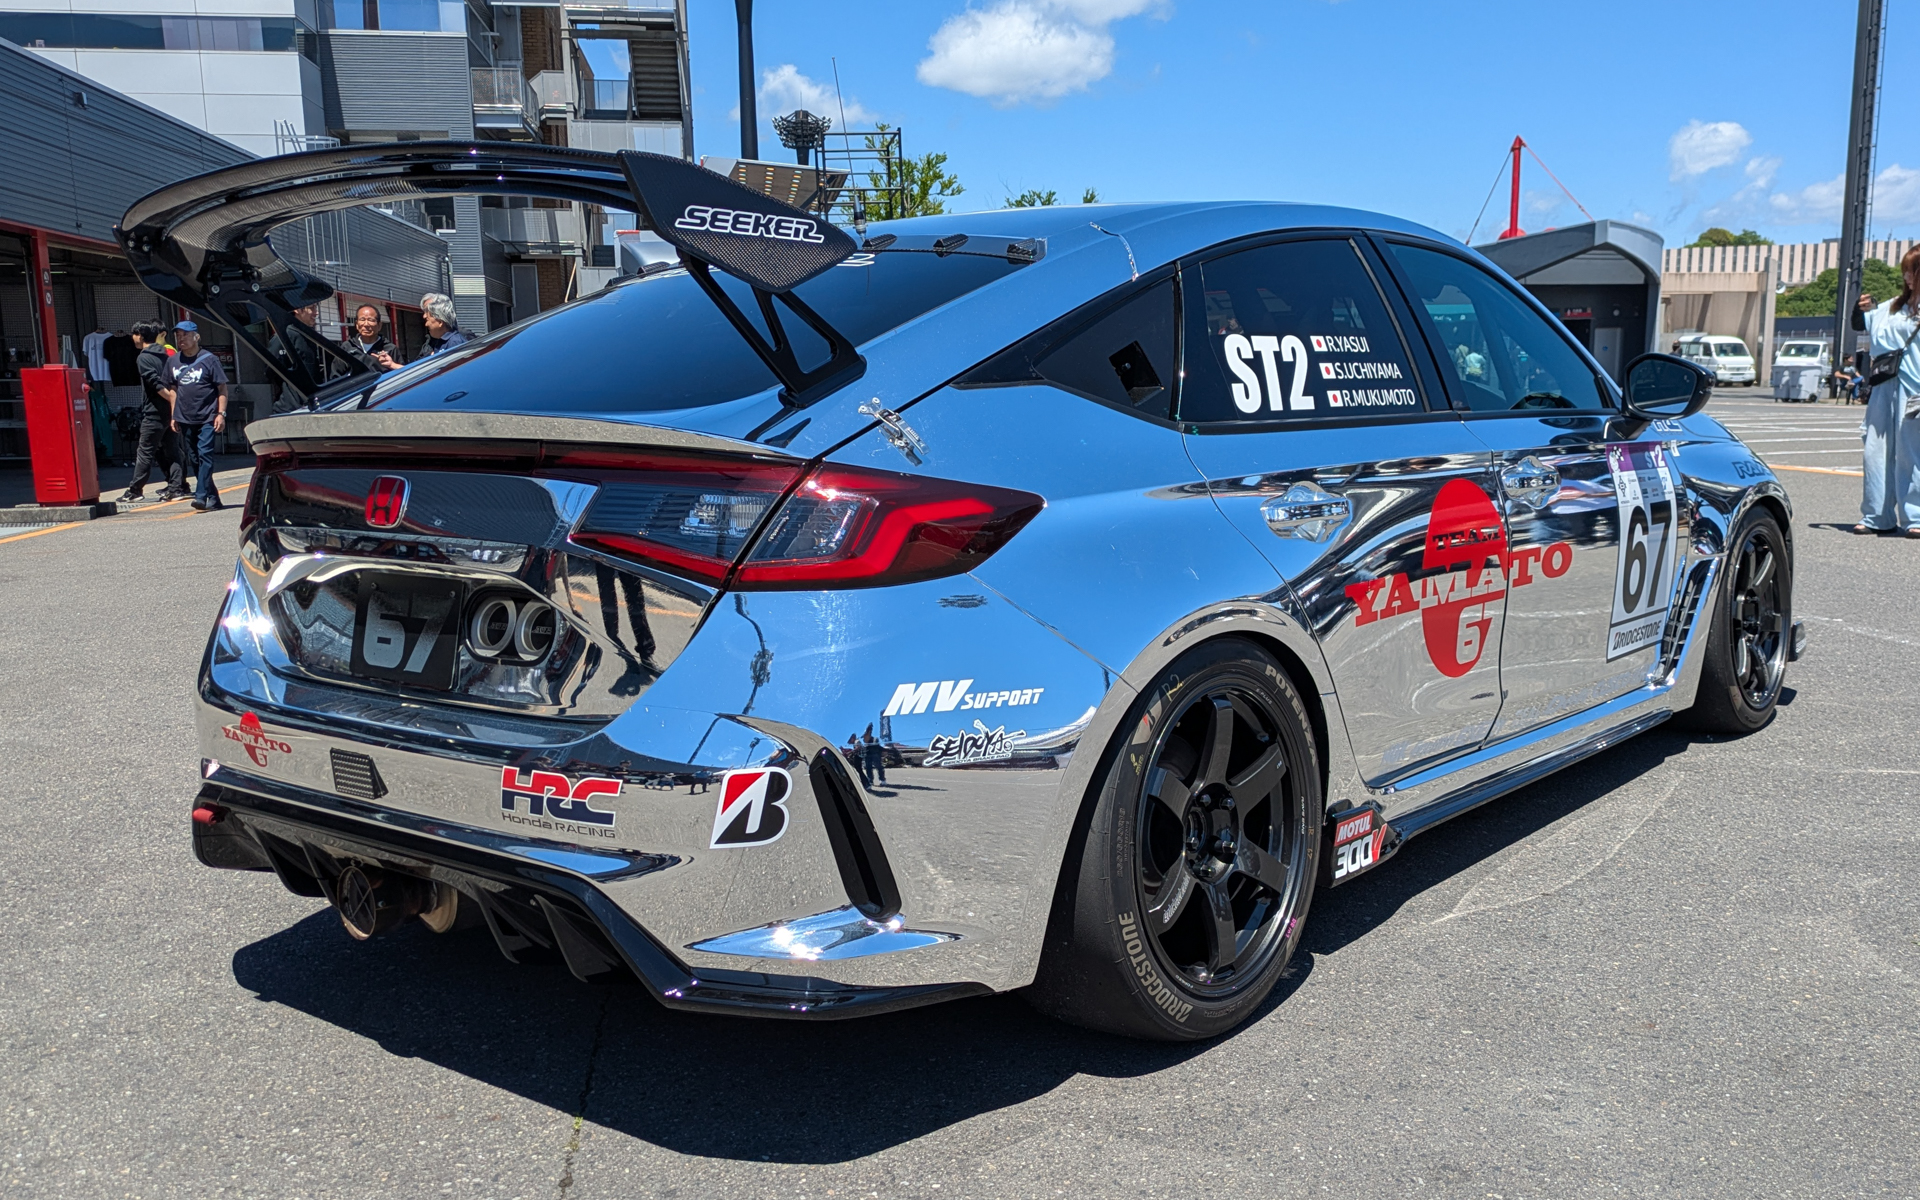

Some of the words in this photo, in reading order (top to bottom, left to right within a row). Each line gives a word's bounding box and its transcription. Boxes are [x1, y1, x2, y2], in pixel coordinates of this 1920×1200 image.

[675, 205, 825, 243] SEEKER
[1327, 335, 1370, 353] R.YASUI
[1224, 334, 1315, 413] ST2
[1334, 362, 1402, 379] S.UCHIYAMA
[1343, 388, 1416, 407] R.MUKUMOTO
[1432, 525, 1501, 551] TEAM
[1622, 500, 1672, 614] 67
[1344, 542, 1573, 627] YAMATO
[363, 590, 454, 674] 67
[1456, 603, 1494, 665] 6
[1612, 620, 1662, 651] BRIDGESTONE
[883, 679, 974, 717] MV
[960, 688, 1044, 710] SUPPORT
[1264, 664, 1317, 768] POTENZA
[221, 726, 292, 754] YAMATO
[501, 765, 623, 827] HRC
[502, 812, 551, 829] Honda
[555, 821, 615, 838] RACING
[1336, 815, 1371, 842] MOTUL
[1335, 823, 1388, 879] 300V
[1118, 911, 1194, 1023] BRIDGESTONE
